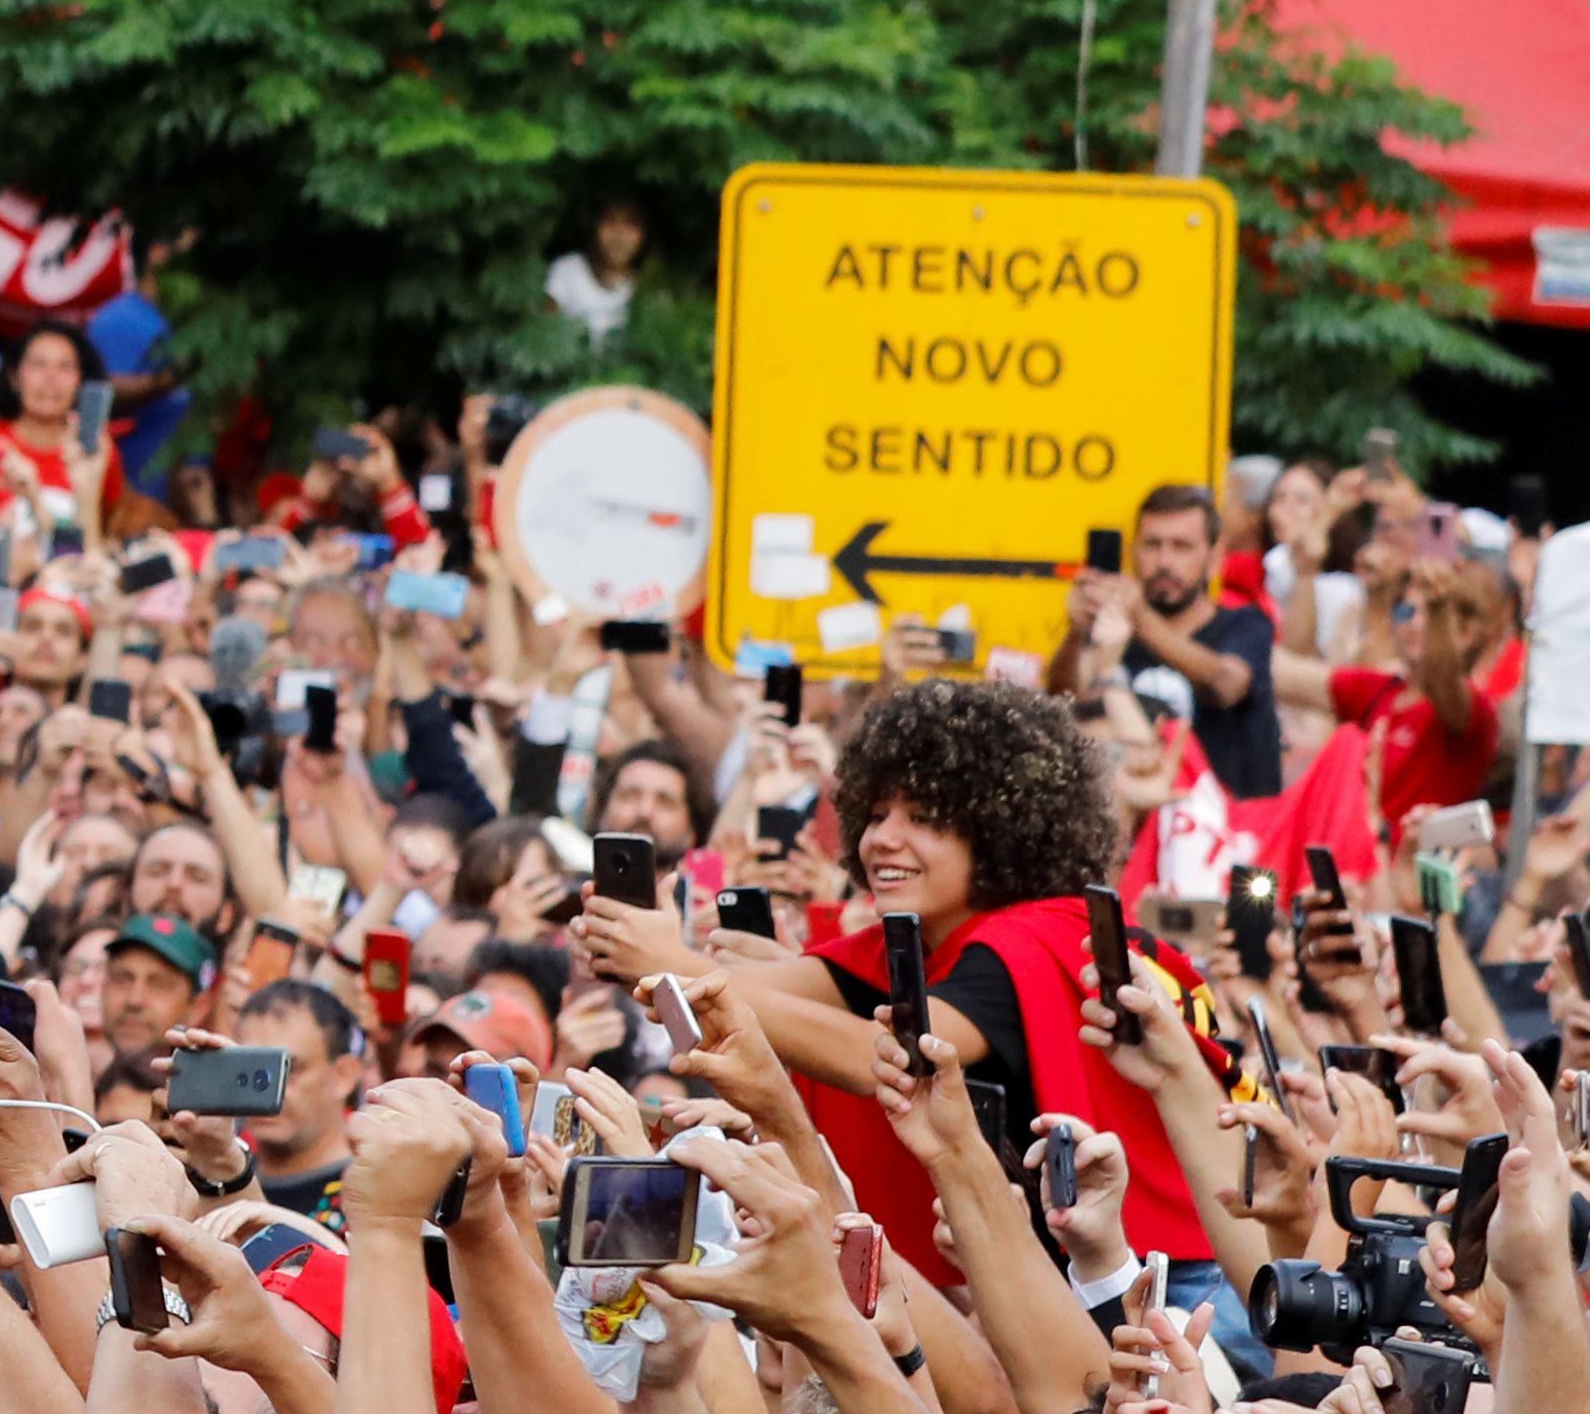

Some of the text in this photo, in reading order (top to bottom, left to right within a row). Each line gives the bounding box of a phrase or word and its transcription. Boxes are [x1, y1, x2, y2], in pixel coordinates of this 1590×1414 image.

[826, 238, 1140, 310] ATENÇÃO
[877, 337, 1062, 387] NOVO
[824, 424, 1116, 482] SENTIDO
